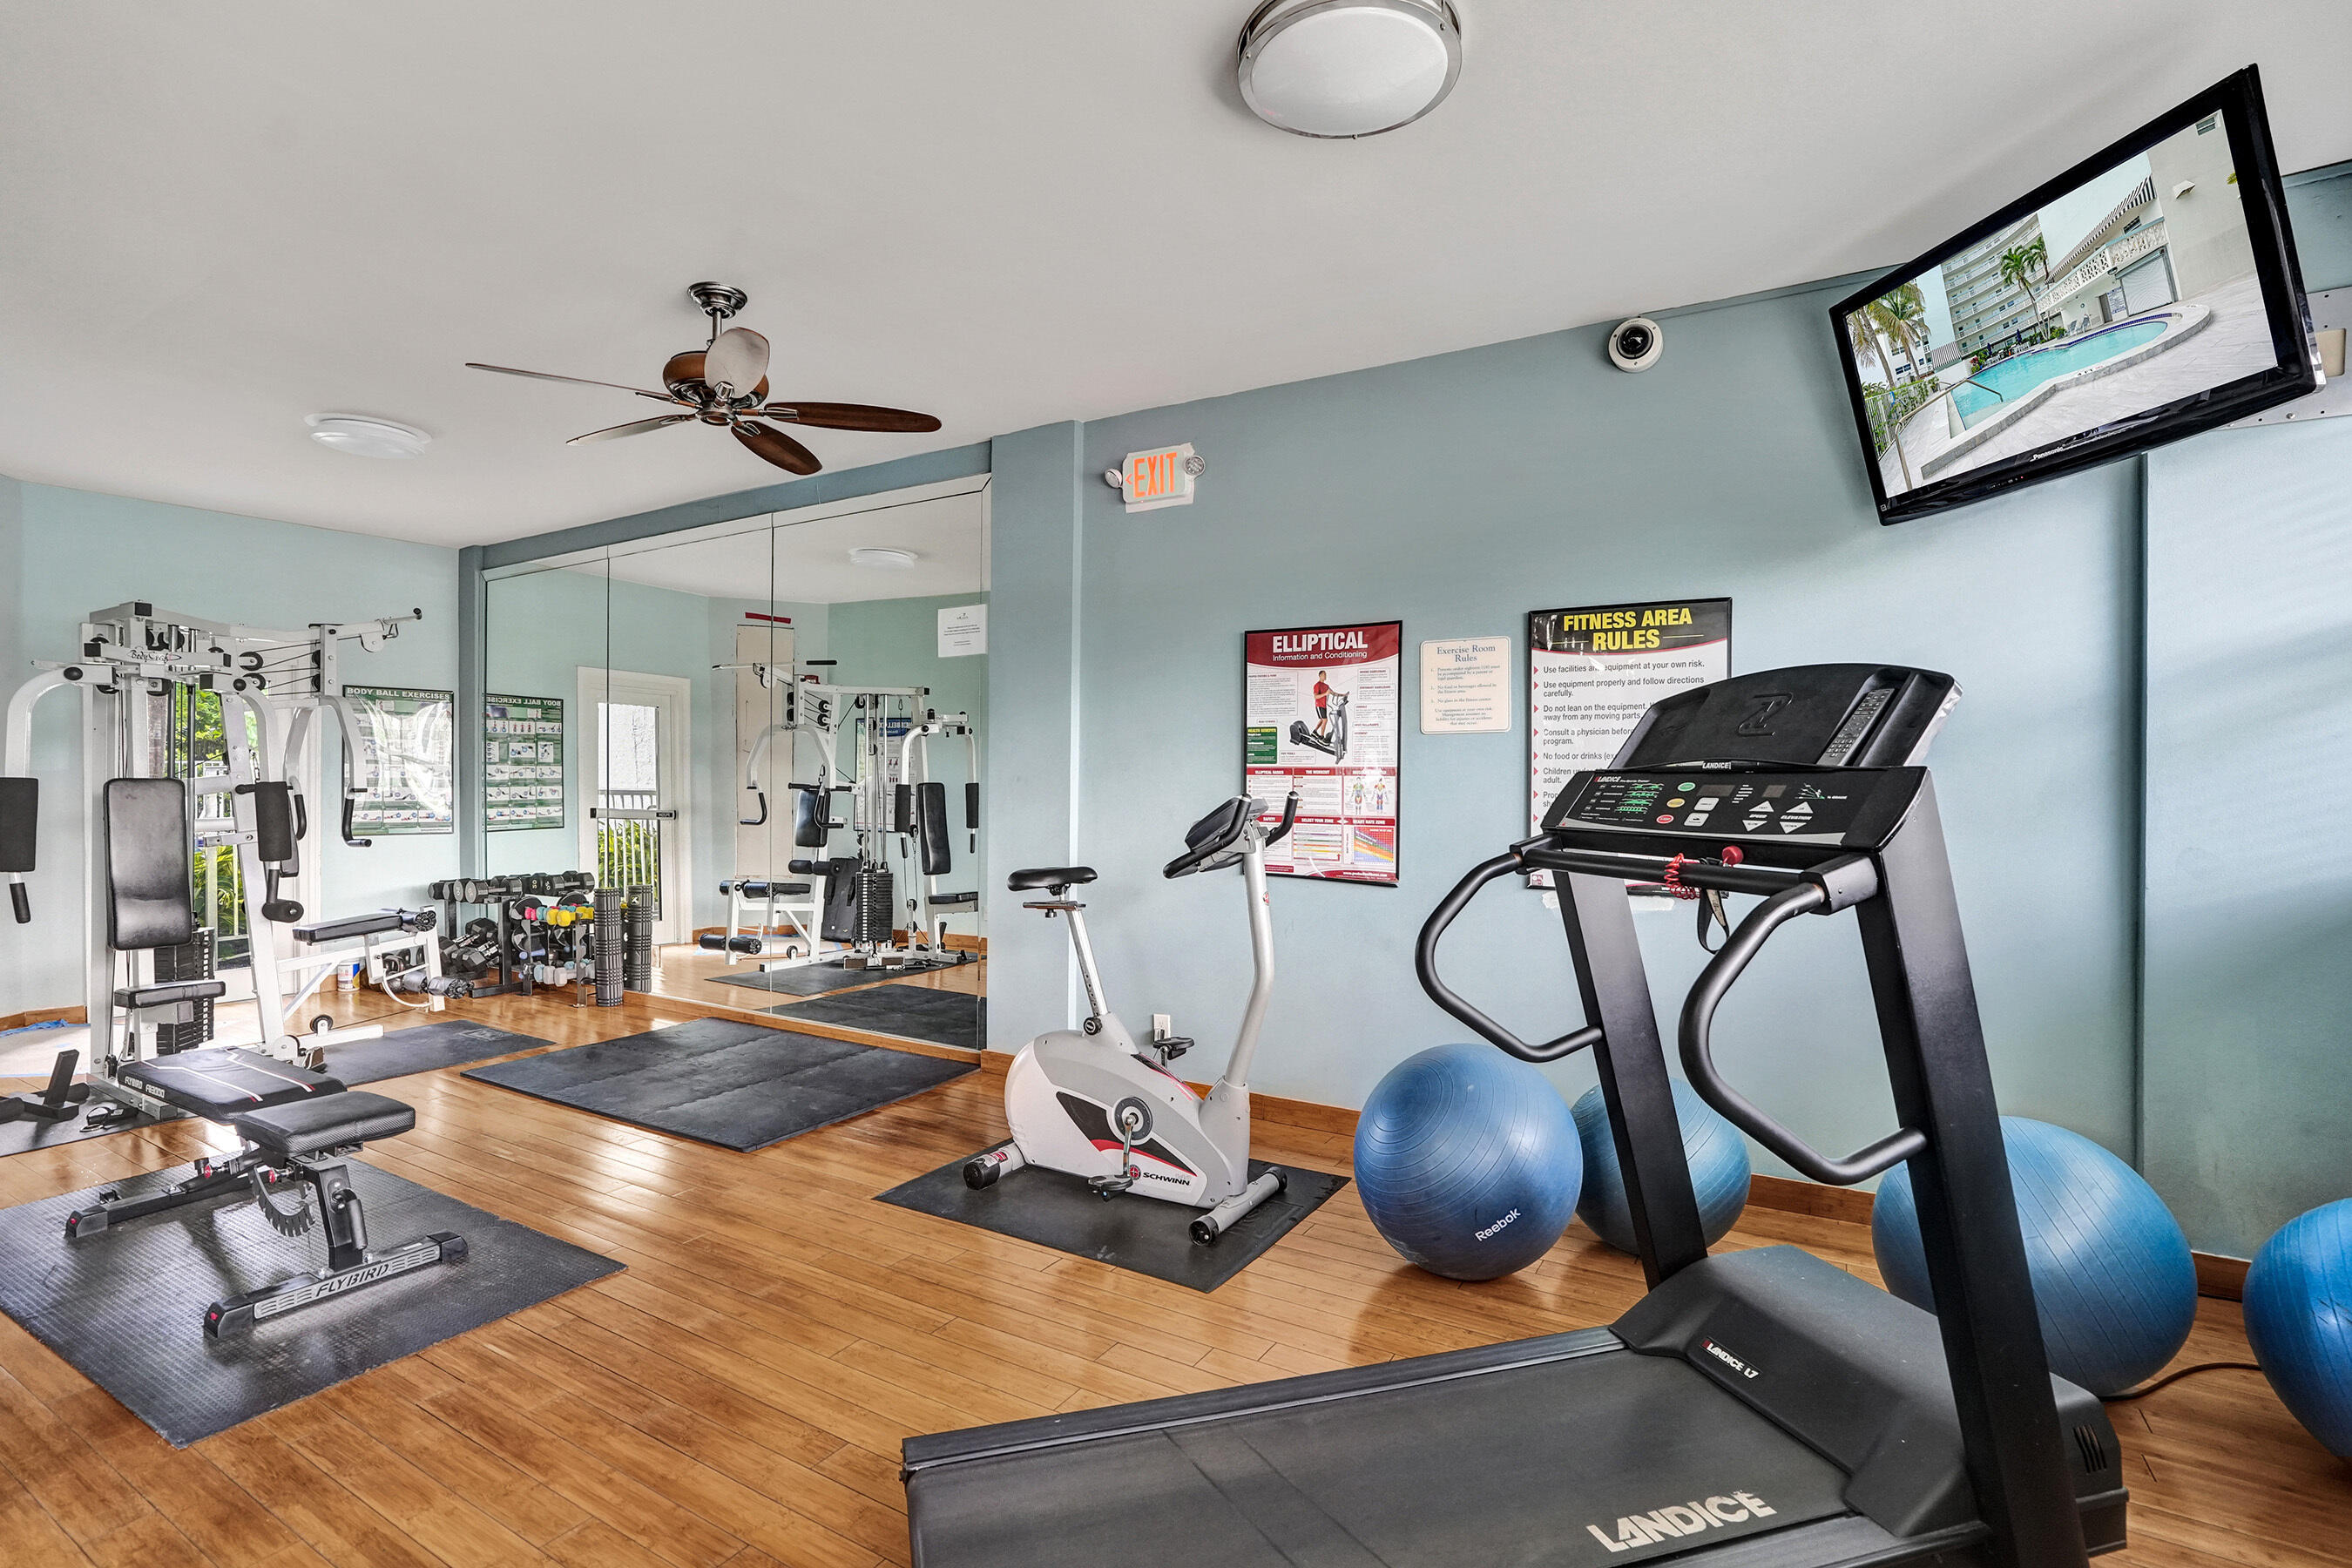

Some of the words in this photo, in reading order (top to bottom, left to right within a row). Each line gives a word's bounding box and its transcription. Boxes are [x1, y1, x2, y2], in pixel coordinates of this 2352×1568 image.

[2033, 446, 2064, 460] Panasonic
[1134, 451, 1177, 498] EXIT
[1564, 612, 1637, 632] FITNESS
[1641, 608, 1693, 627] AREA
[1273, 631, 1369, 653] ELLIPTICAL
[1592, 629, 1660, 651] RULES
[1324, 651, 1368, 659] Conditioning
[1436, 646, 1470, 655] Exercise
[1558, 665, 1587, 673] facilities
[1652, 662, 1668, 671] your
[1558, 680, 1594, 690] equipment
[1596, 679, 1625, 688] properly
[1667, 676, 1705, 685] directions
[402, 690, 450, 700] EXERCISES
[1544, 689, 1573, 699] carefully.
[1607, 702, 1647, 712] equipment.
[1594, 713, 1620, 721] moving
[1577, 727, 1610, 737] physician
[1702, 761, 1730, 770] LANDICE
[1143, 1173, 1190, 1186] SCHWINN
[1475, 1208, 1521, 1241] Reebok
[316, 1264, 389, 1297] FLYBIRD
[1707, 1342, 1745, 1371] LANDICE
[1744, 1368, 1759, 1379] L7
[1585, 1489, 1778, 1552] LANDICE
